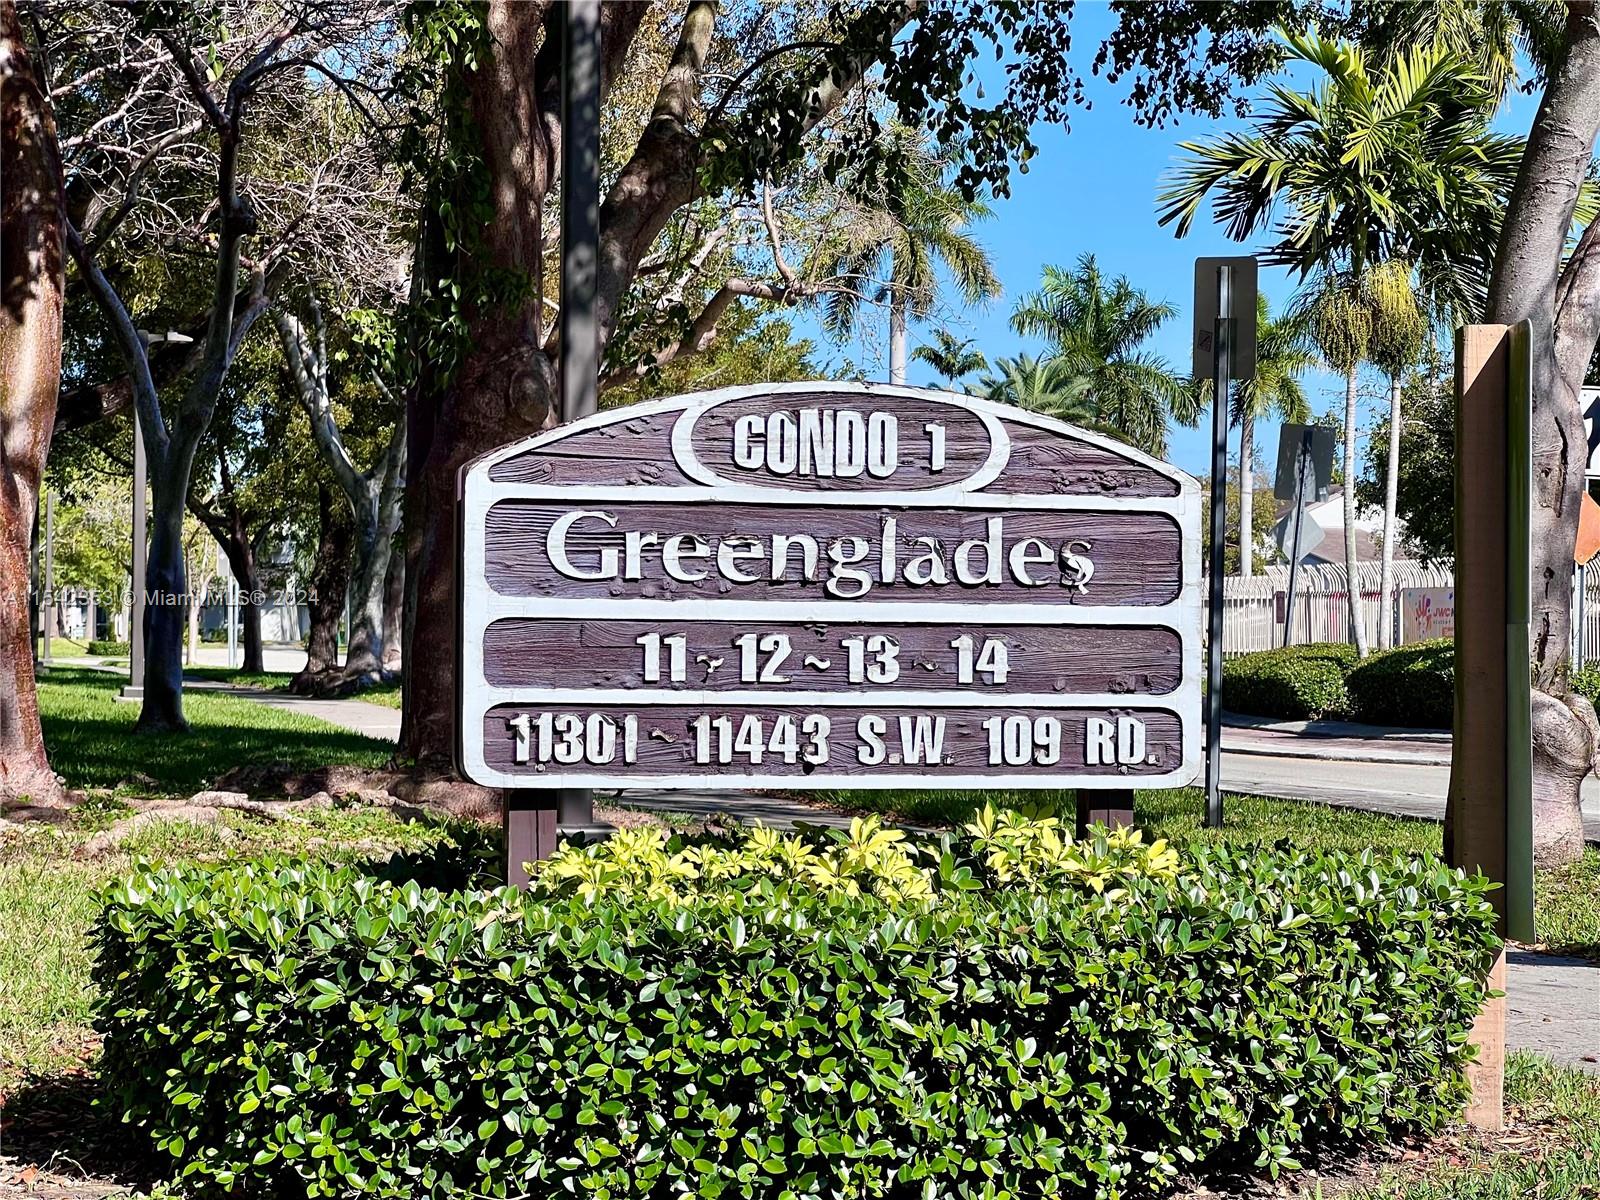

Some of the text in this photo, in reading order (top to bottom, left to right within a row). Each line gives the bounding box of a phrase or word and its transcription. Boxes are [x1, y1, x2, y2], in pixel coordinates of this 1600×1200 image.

[733, 408, 946, 479] CONDO 1
[546, 510, 1096, 599] Greenglades
[636, 632, 687, 683] 11
[735, 632, 793, 683] 12
[842, 634, 900, 684] 13
[951, 634, 1011, 685] 14
[509, 711, 639, 764] 11301
[693, 713, 831, 766] 11443
[983, 715, 1062, 766] 109
[1086, 715, 1159, 766] RD.
